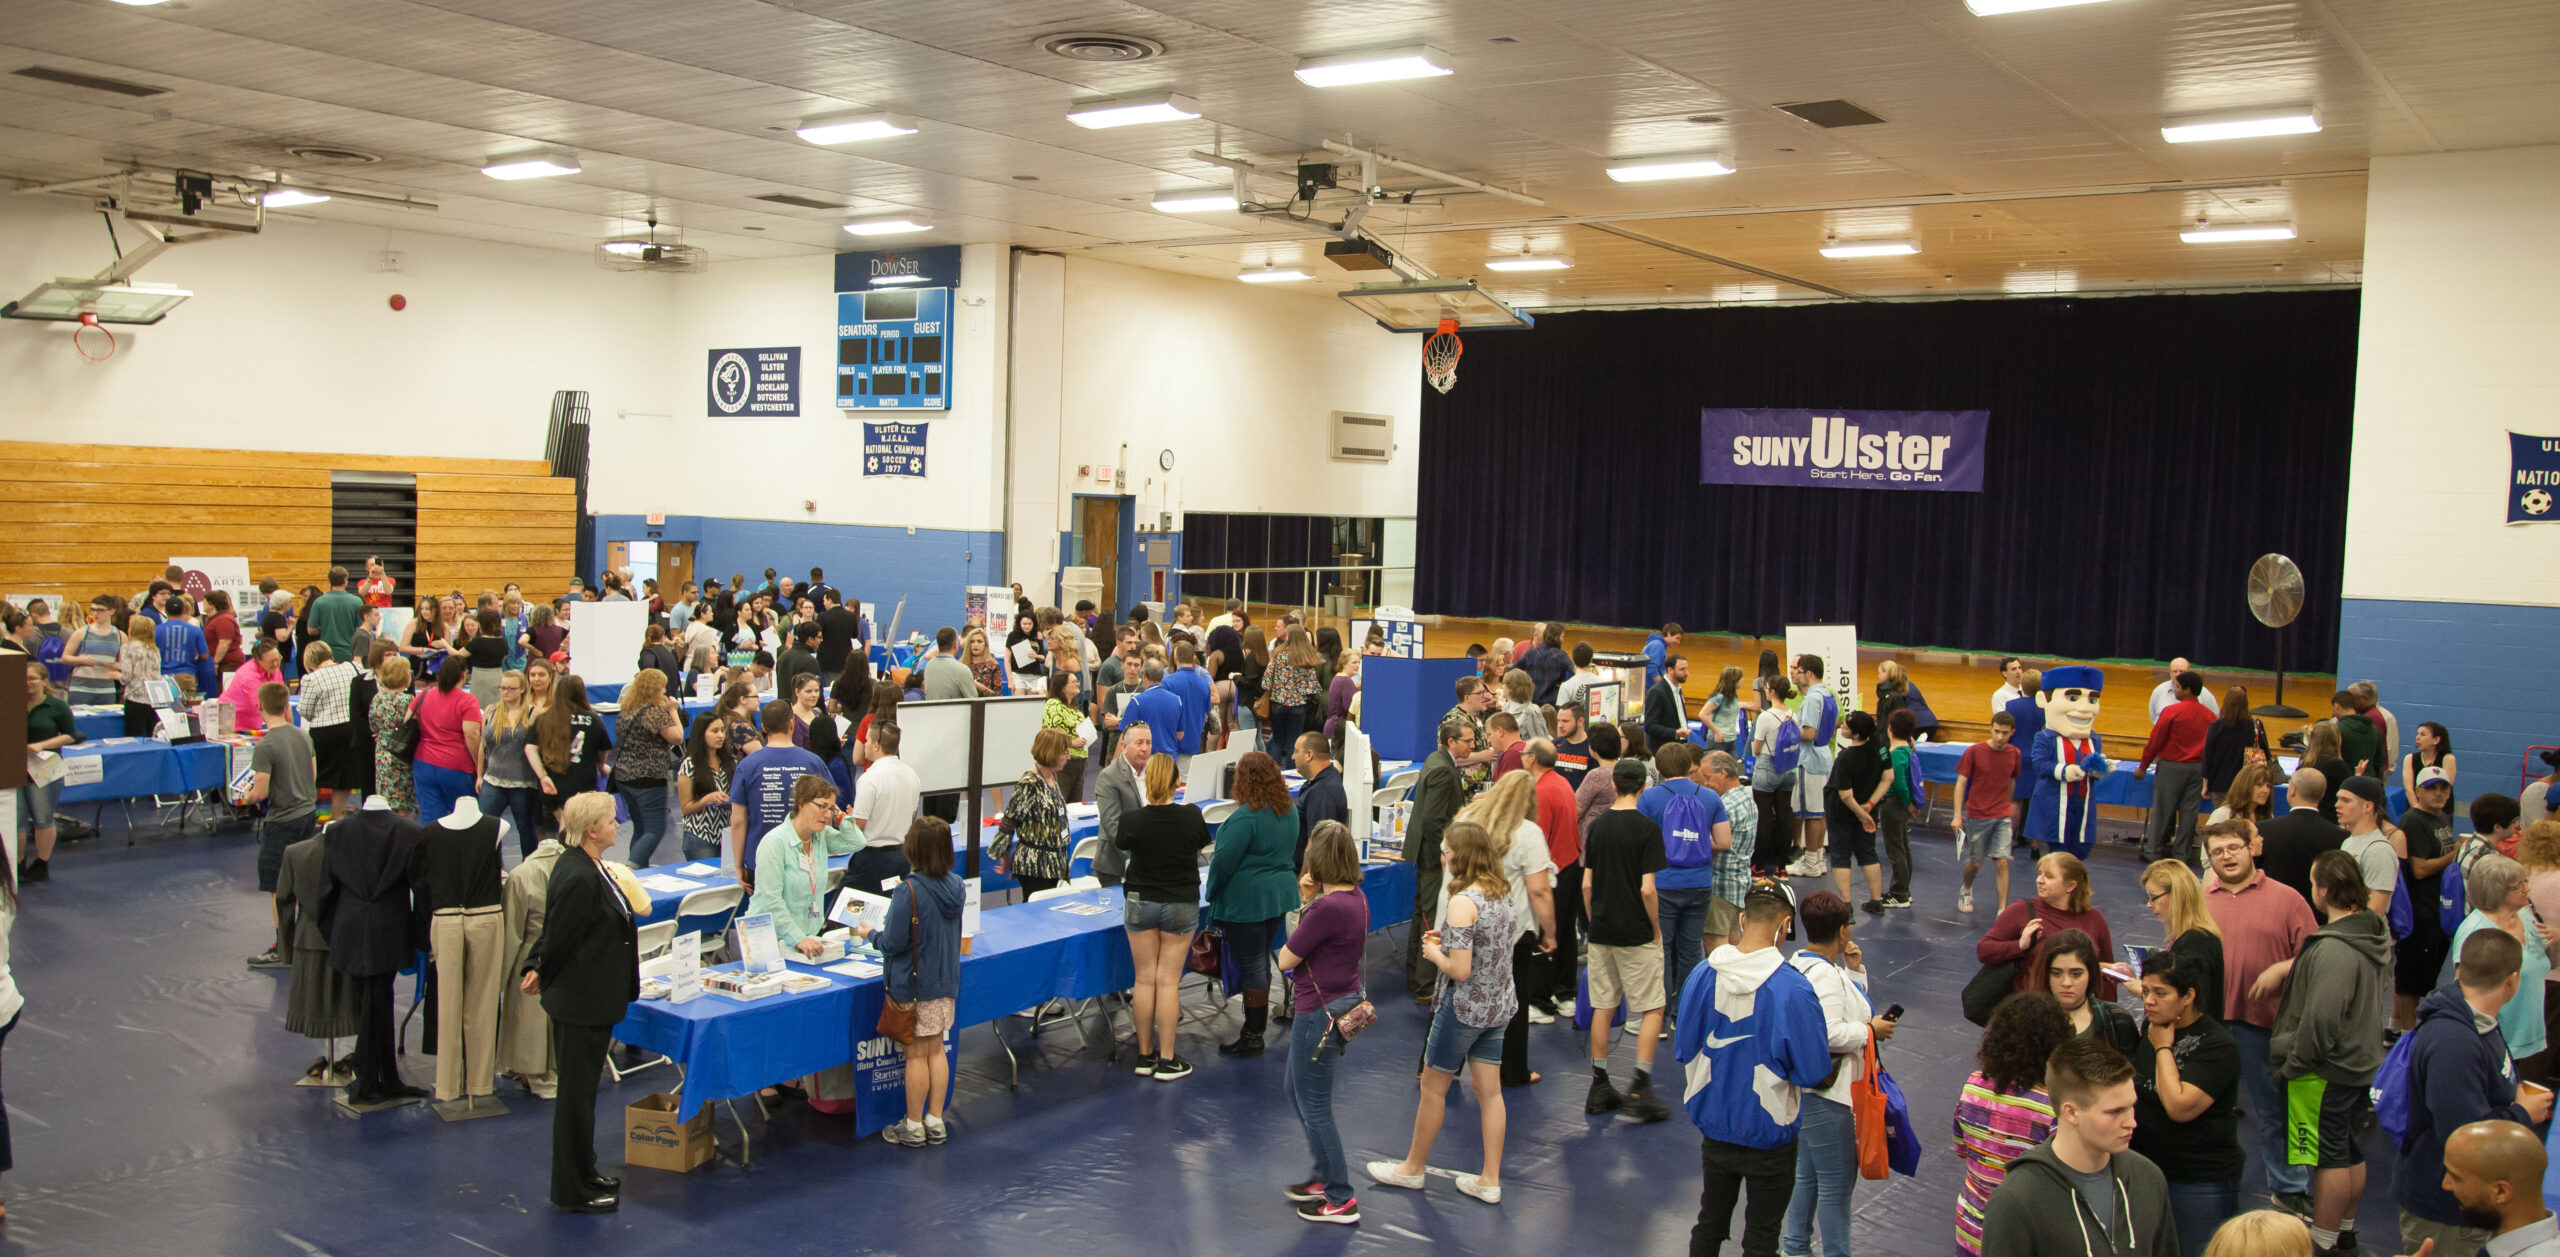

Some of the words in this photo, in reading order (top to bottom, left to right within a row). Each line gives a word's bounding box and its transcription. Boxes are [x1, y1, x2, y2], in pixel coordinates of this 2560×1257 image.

[839, 324, 877, 336] SENATORS
[914, 322, 940, 334] GUEST
[881, 330, 899, 338] PERIOD
[758, 353, 788, 361] SULLIVAN
[761, 363, 784, 371] ULSTER
[838, 367, 855, 375] FOULS
[872, 366, 892, 374] PLAYER
[894, 365, 907, 374] FOUL
[924, 365, 942, 373] FOULS
[760, 373, 785, 381] ORANGE
[756, 383, 789, 391] ROCKLAND
[757, 393, 788, 401] DUTCHESS
[879, 398, 898, 406] MATCH
[923, 398, 941, 406] SCORE
[750, 403, 794, 411] WESTCHESTER
[874, 425, 899, 433] ULSTER
[866, 444, 892, 454] NATIONAL
[894, 445, 924, 455] CHAMPION
[882, 456, 906, 464] SOCCER
[1810, 469, 1848, 480] Start
[1850, 470, 1886, 480] Here.
[1890, 471, 1911, 481] Go
[1914, 472, 1943, 482] Far.
[1557, 753, 1588, 765] YRACUSE
[857, 1061, 874, 1071] Ulster
[876, 1055, 896, 1067] County
[874, 1069, 891, 1081] Start
